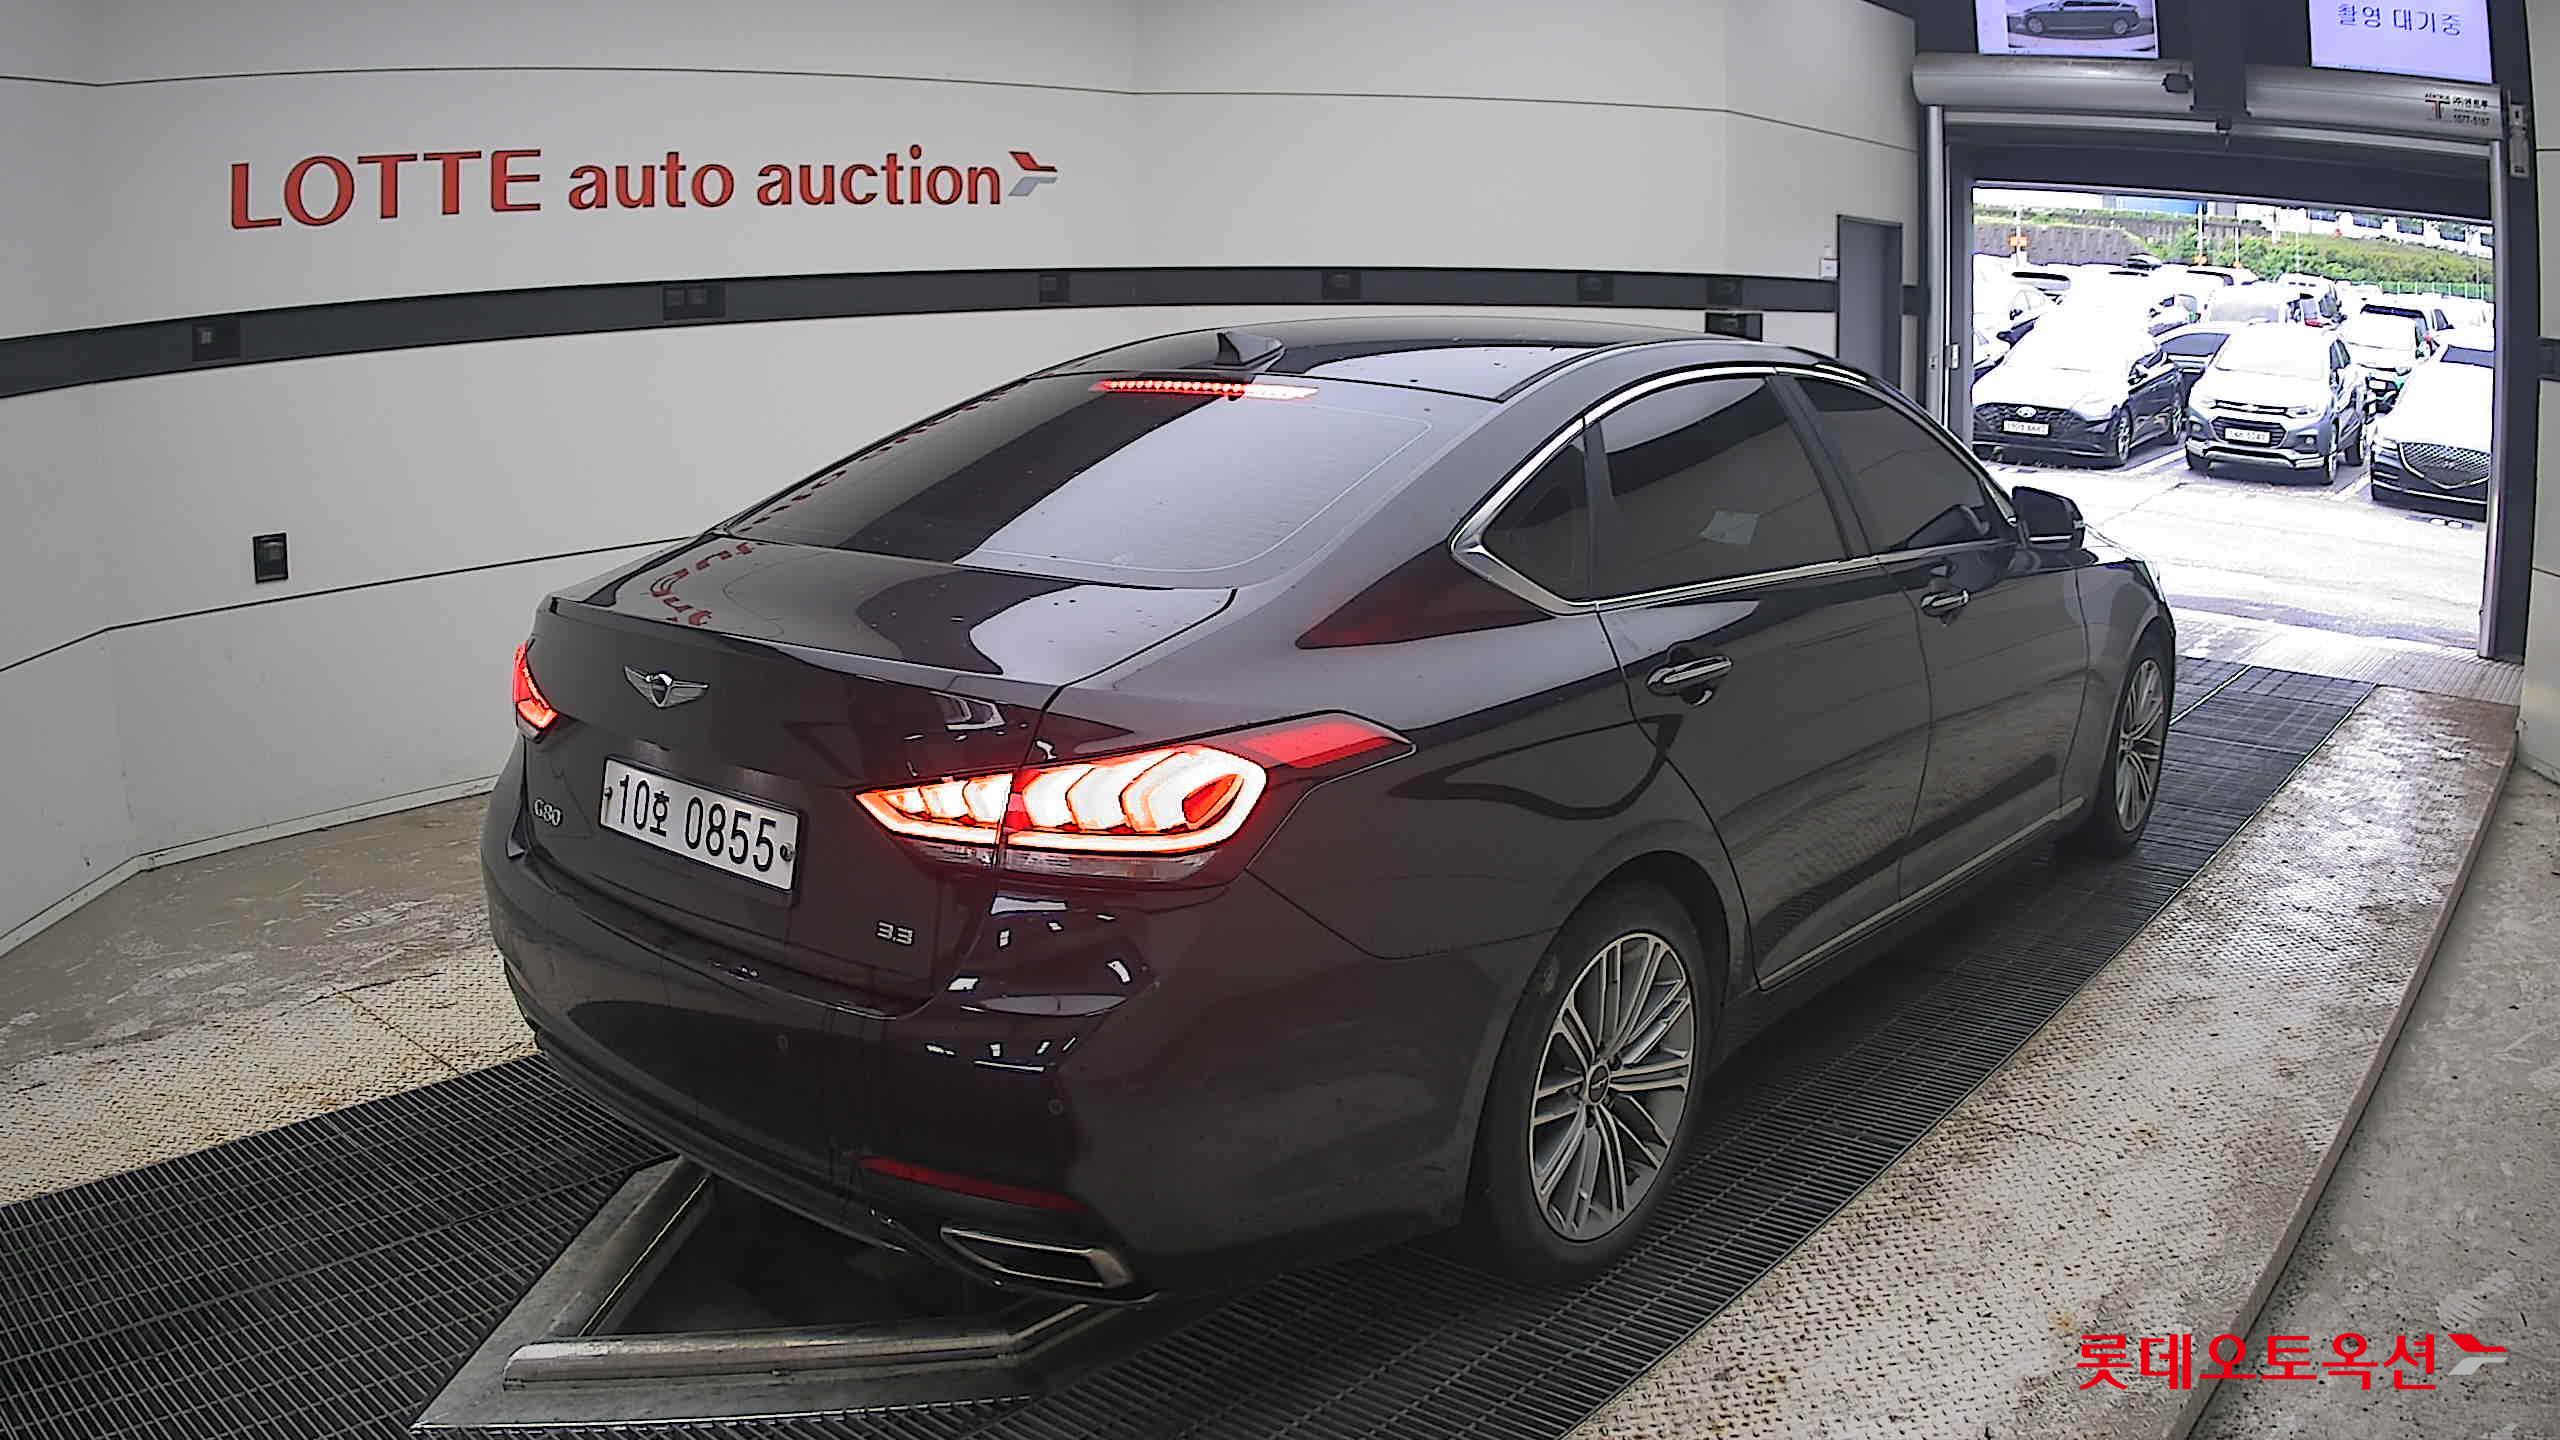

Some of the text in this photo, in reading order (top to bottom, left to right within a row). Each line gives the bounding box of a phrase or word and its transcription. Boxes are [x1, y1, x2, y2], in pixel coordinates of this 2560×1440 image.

[2338, 4, 2461, 36] 촬영 대기중
[230, 145, 1001, 230] LOTTE auto auction
[534, 799, 561, 826] G80
[618, 773, 775, 872] 10호 0855
